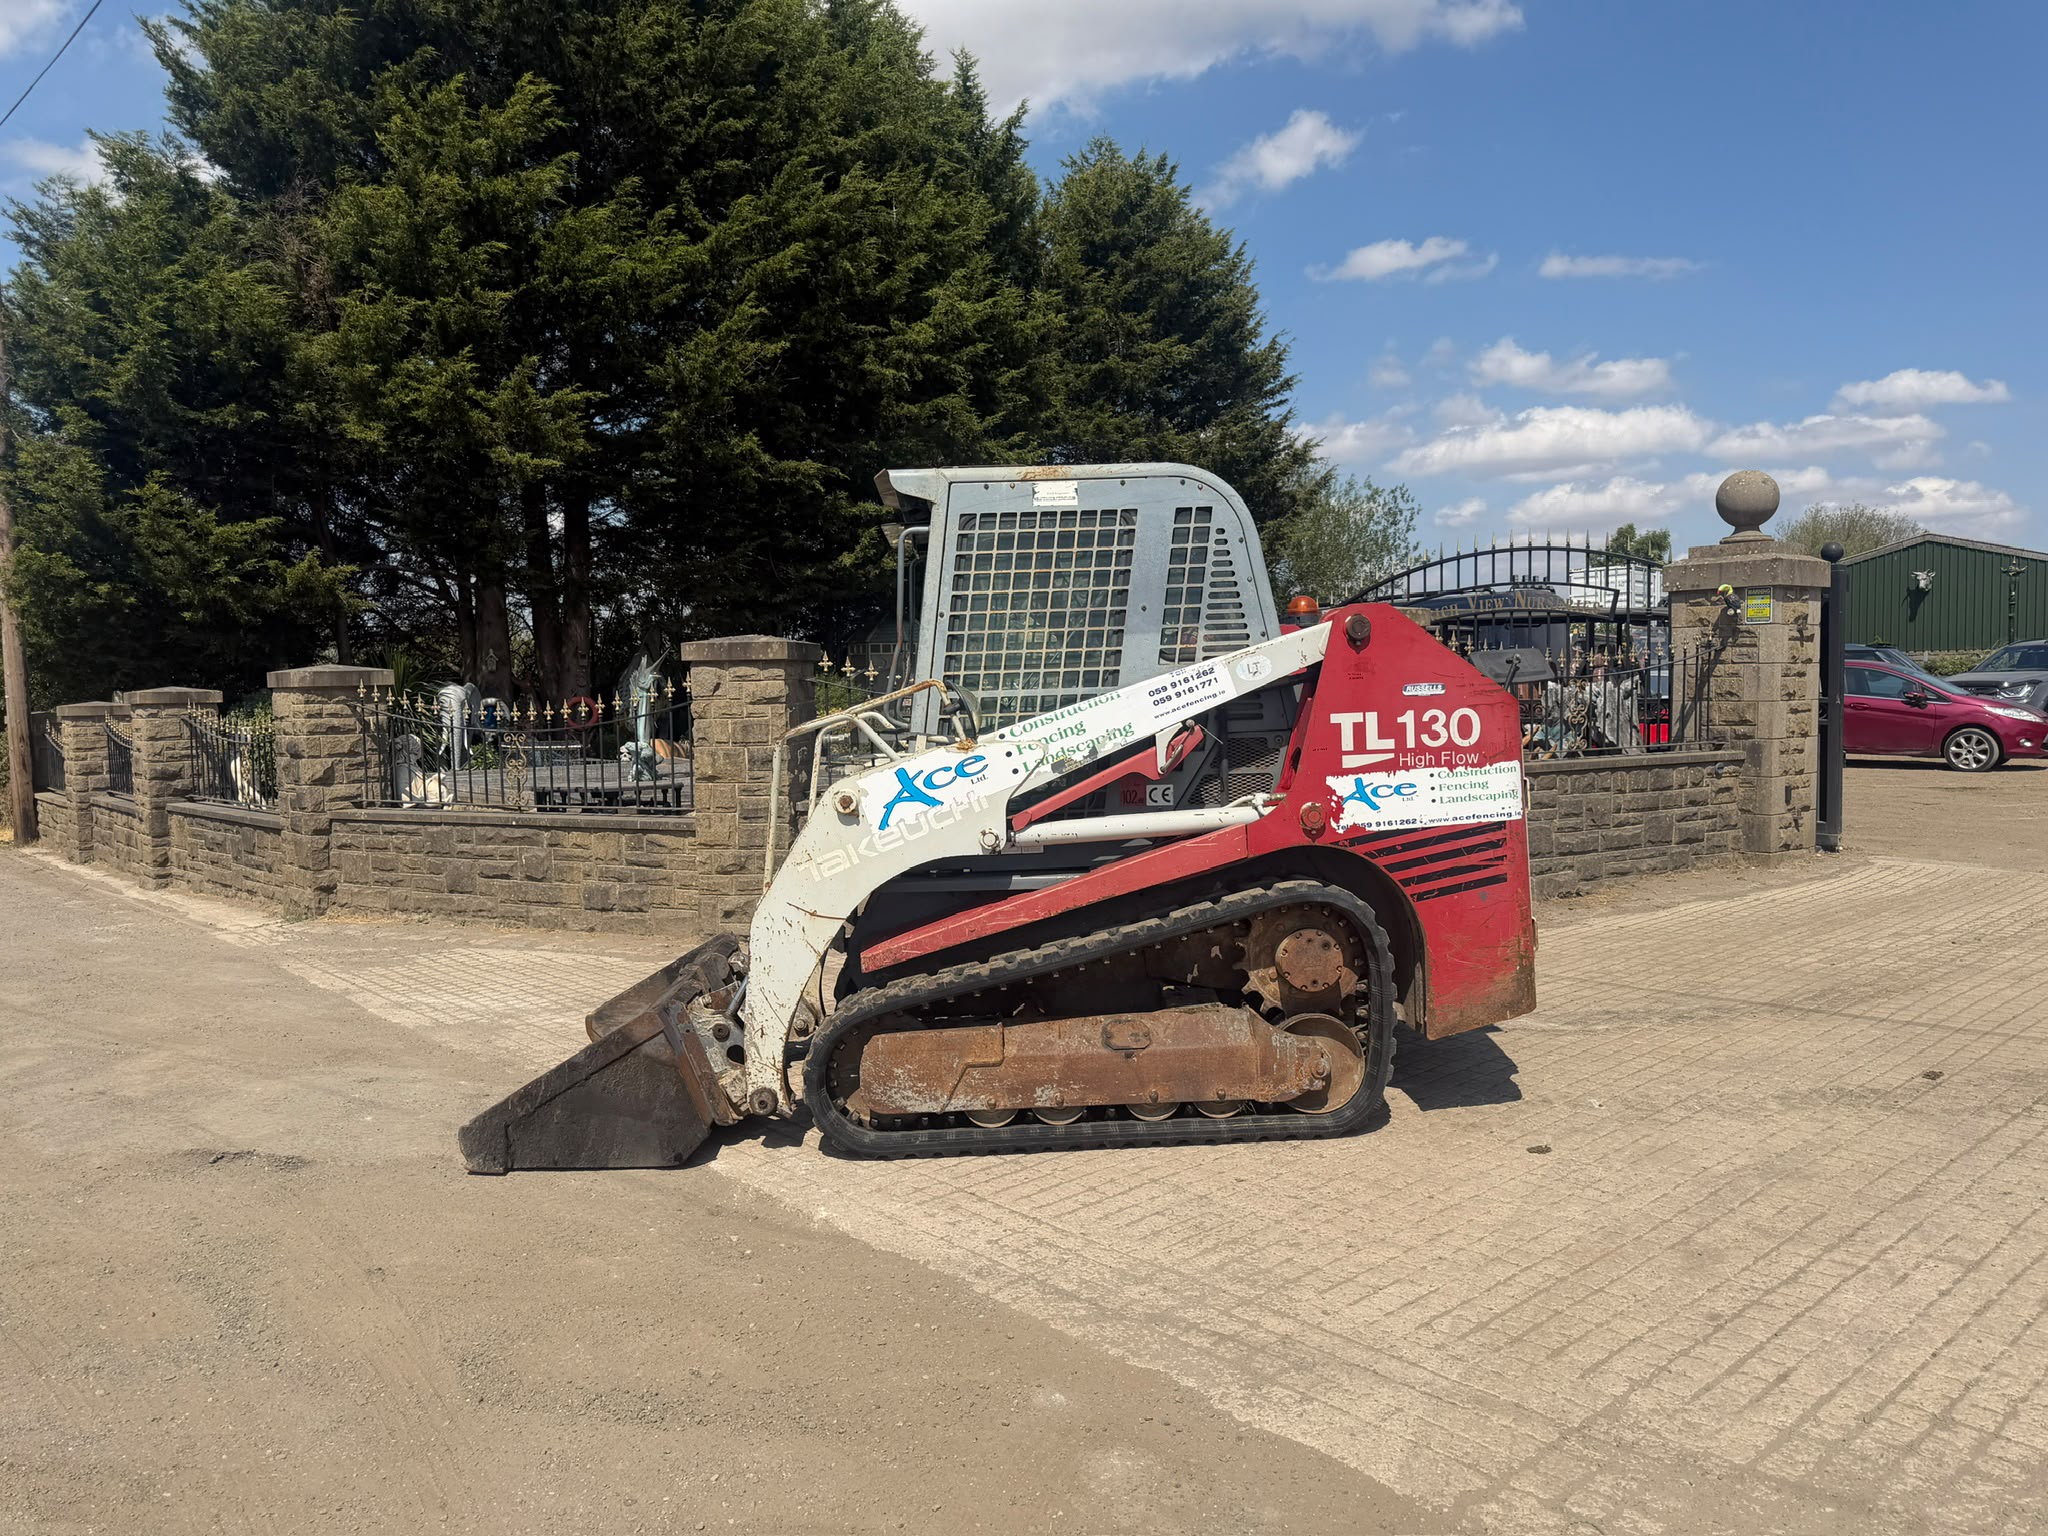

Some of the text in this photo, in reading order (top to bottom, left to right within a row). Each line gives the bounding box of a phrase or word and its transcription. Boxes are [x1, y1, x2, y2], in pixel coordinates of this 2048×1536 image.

[1148, 667, 1216, 697] 059 9161262
[1406, 684, 1442, 692] RUSSELLS
[1152, 677, 1219, 707] 059 9161771
[1154, 689, 1226, 720] www.acefencing.ie
[1399, 751, 1480, 768] High Flow
[1437, 765, 1517, 780] Construction
[1439, 780, 1489, 791] Fencing
[1440, 789, 1519, 804] Landscaping
[1375, 818, 1418, 828] 9161262
